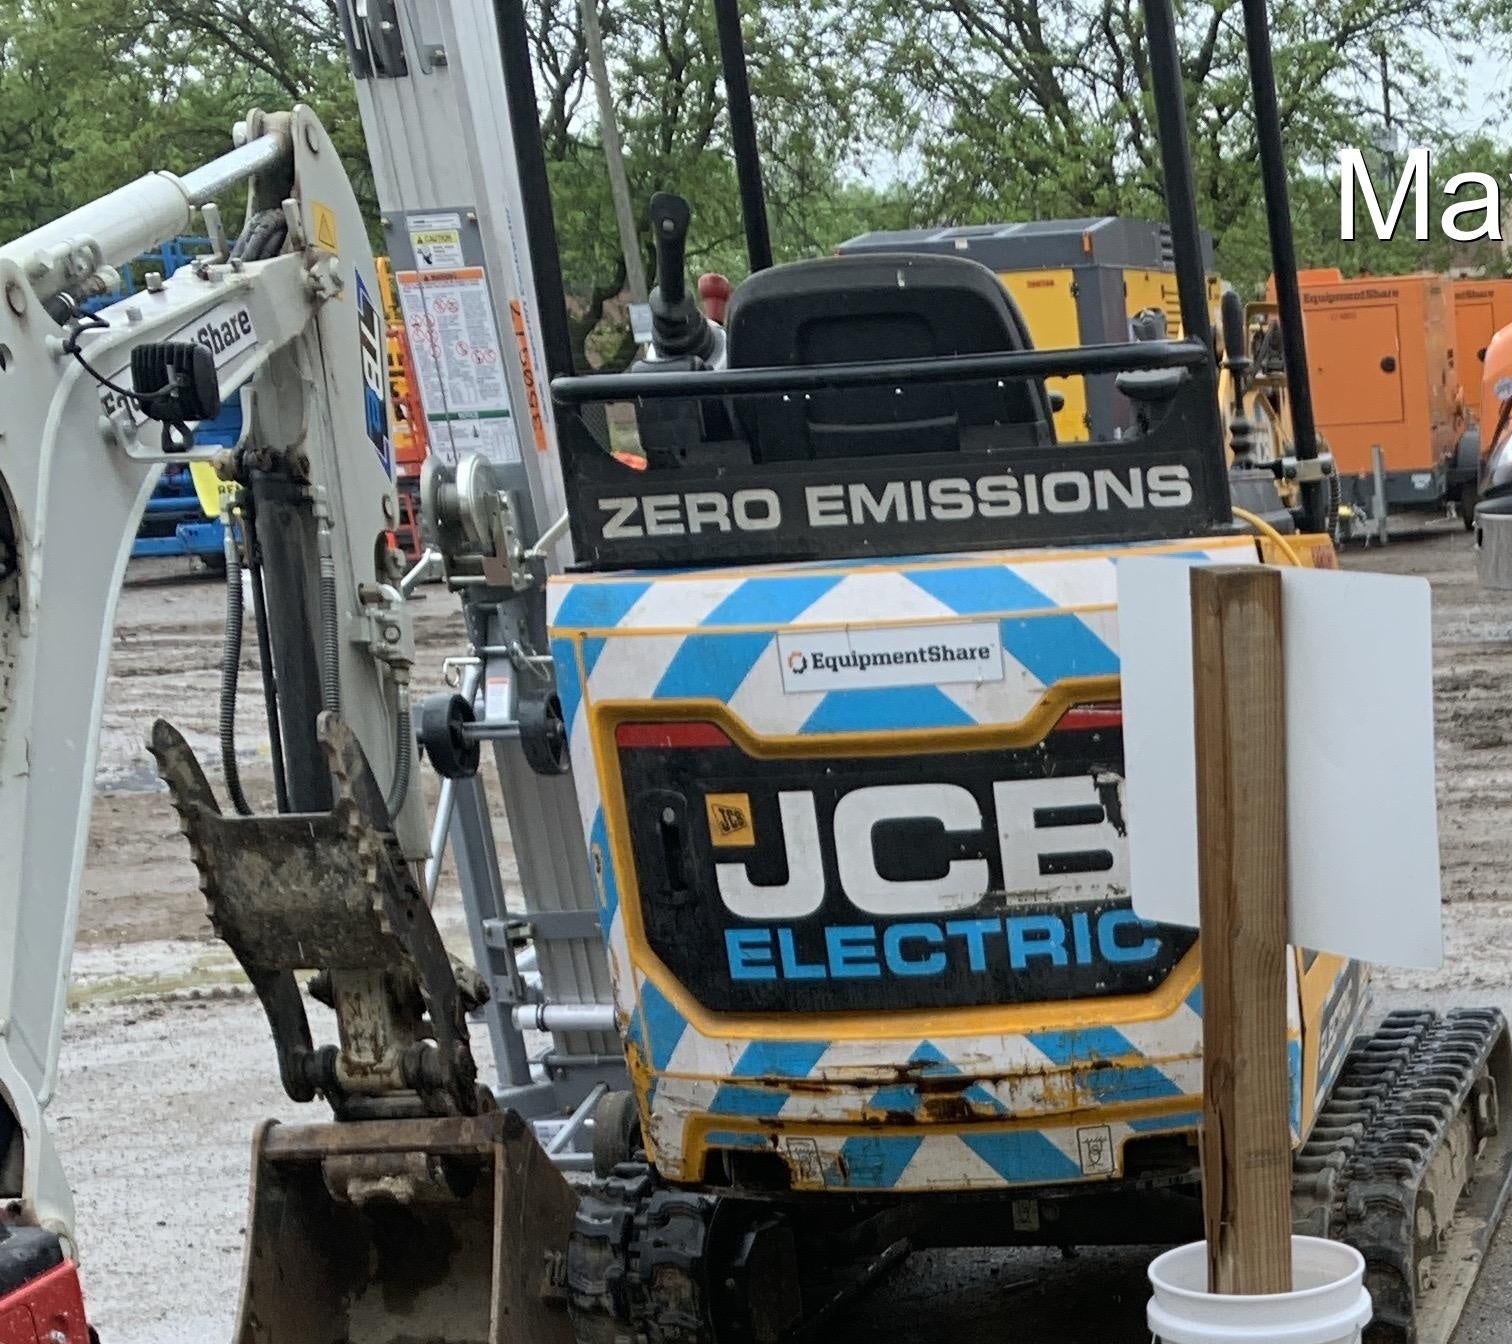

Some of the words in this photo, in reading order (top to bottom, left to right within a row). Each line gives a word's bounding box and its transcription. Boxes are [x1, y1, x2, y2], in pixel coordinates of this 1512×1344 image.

[1303, 289, 1399, 304] EquipmentShare
[600, 488, 782, 541] ZERO
[806, 464, 1195, 528] EMISSIONS
[811, 645, 991, 673] EquipmentShare
[714, 803, 747, 837] JCB
[716, 775, 1131, 920] JCB
[723, 909, 1160, 983] ELECTRIC
